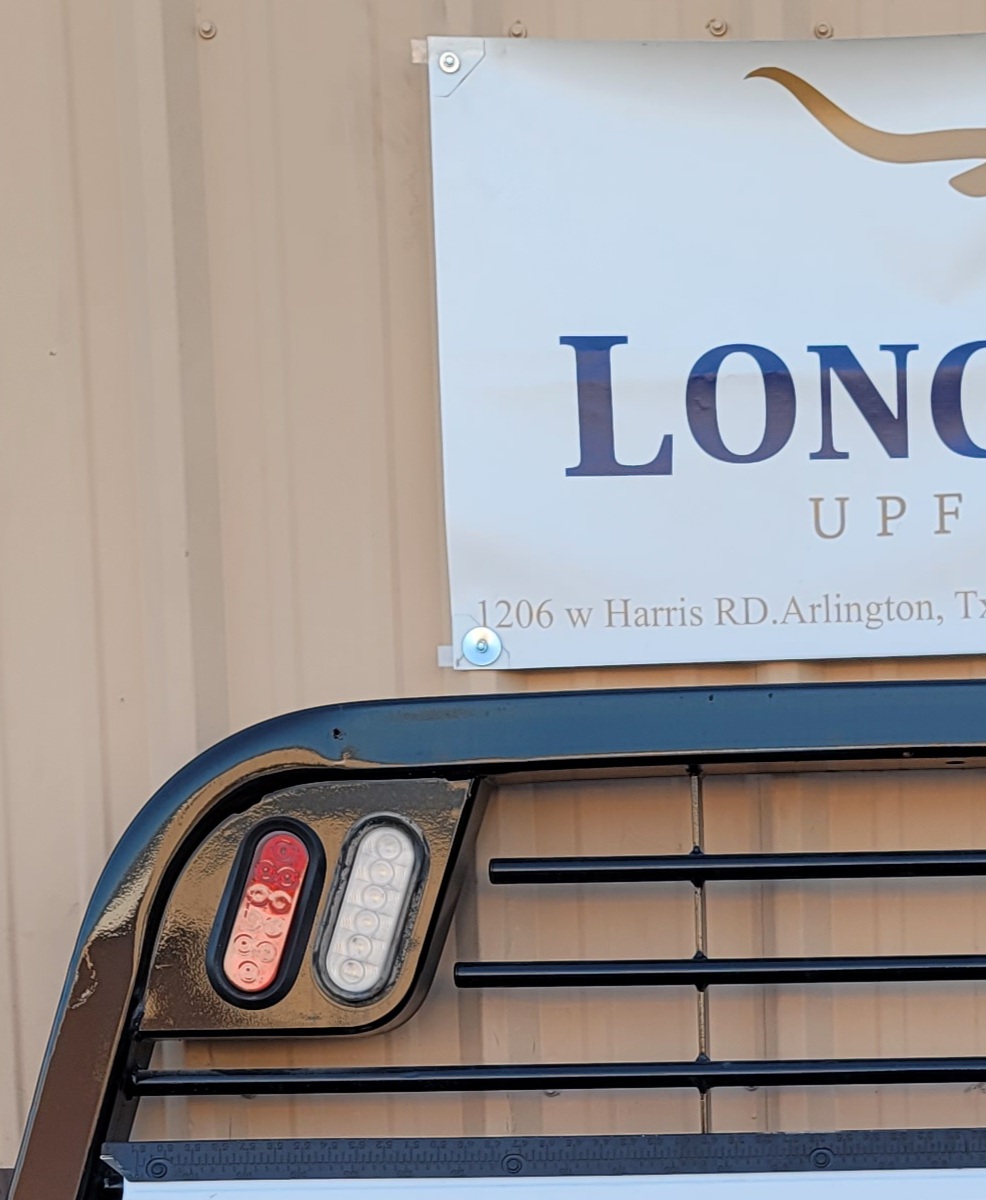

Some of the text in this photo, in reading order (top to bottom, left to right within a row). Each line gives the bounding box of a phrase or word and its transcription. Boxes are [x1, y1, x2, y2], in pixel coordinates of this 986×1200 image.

[478, 599, 554, 629] 1206
[565, 607, 594, 628] w
[604, 598, 704, 628] Harris
